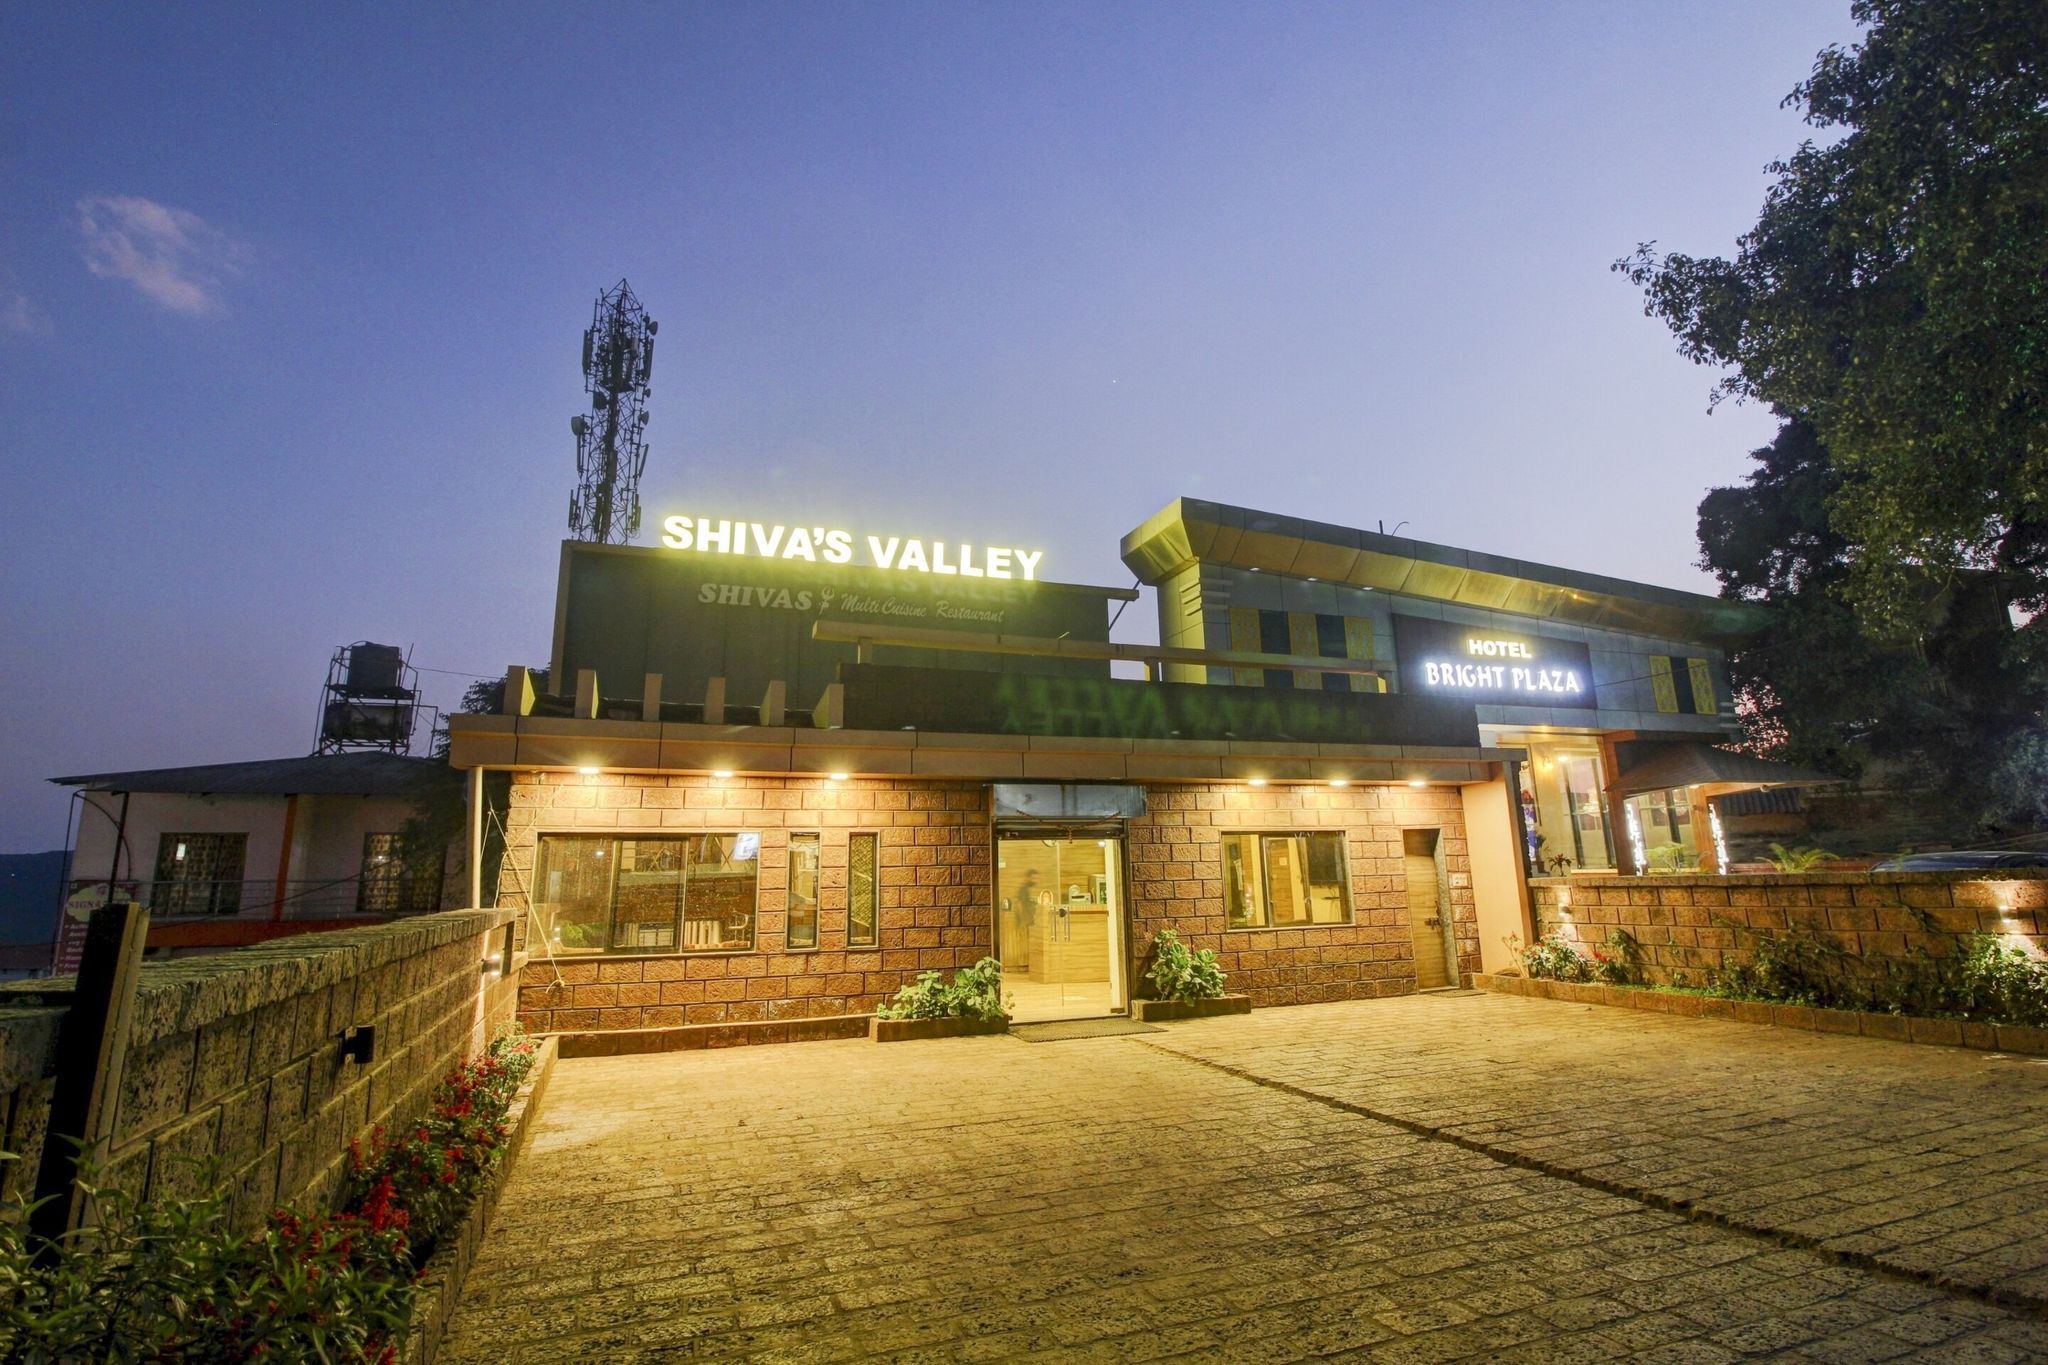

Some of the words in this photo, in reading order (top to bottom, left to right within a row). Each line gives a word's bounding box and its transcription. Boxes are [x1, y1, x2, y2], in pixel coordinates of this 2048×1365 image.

[662, 515, 852, 564] SHIVA'S
[867, 536, 1042, 580] VALLEY
[698, 583, 813, 610] SHIVAS
[840, 593, 880, 613] Multi
[881, 597, 928, 617] Cuisine
[936, 601, 1004, 623] Restaurant
[1467, 639, 1532, 659] HOTEL
[1425, 662, 1505, 688] BRIGHT
[1511, 667, 1581, 692] PLAZA
[69, 900, 103, 909] SIGNA
